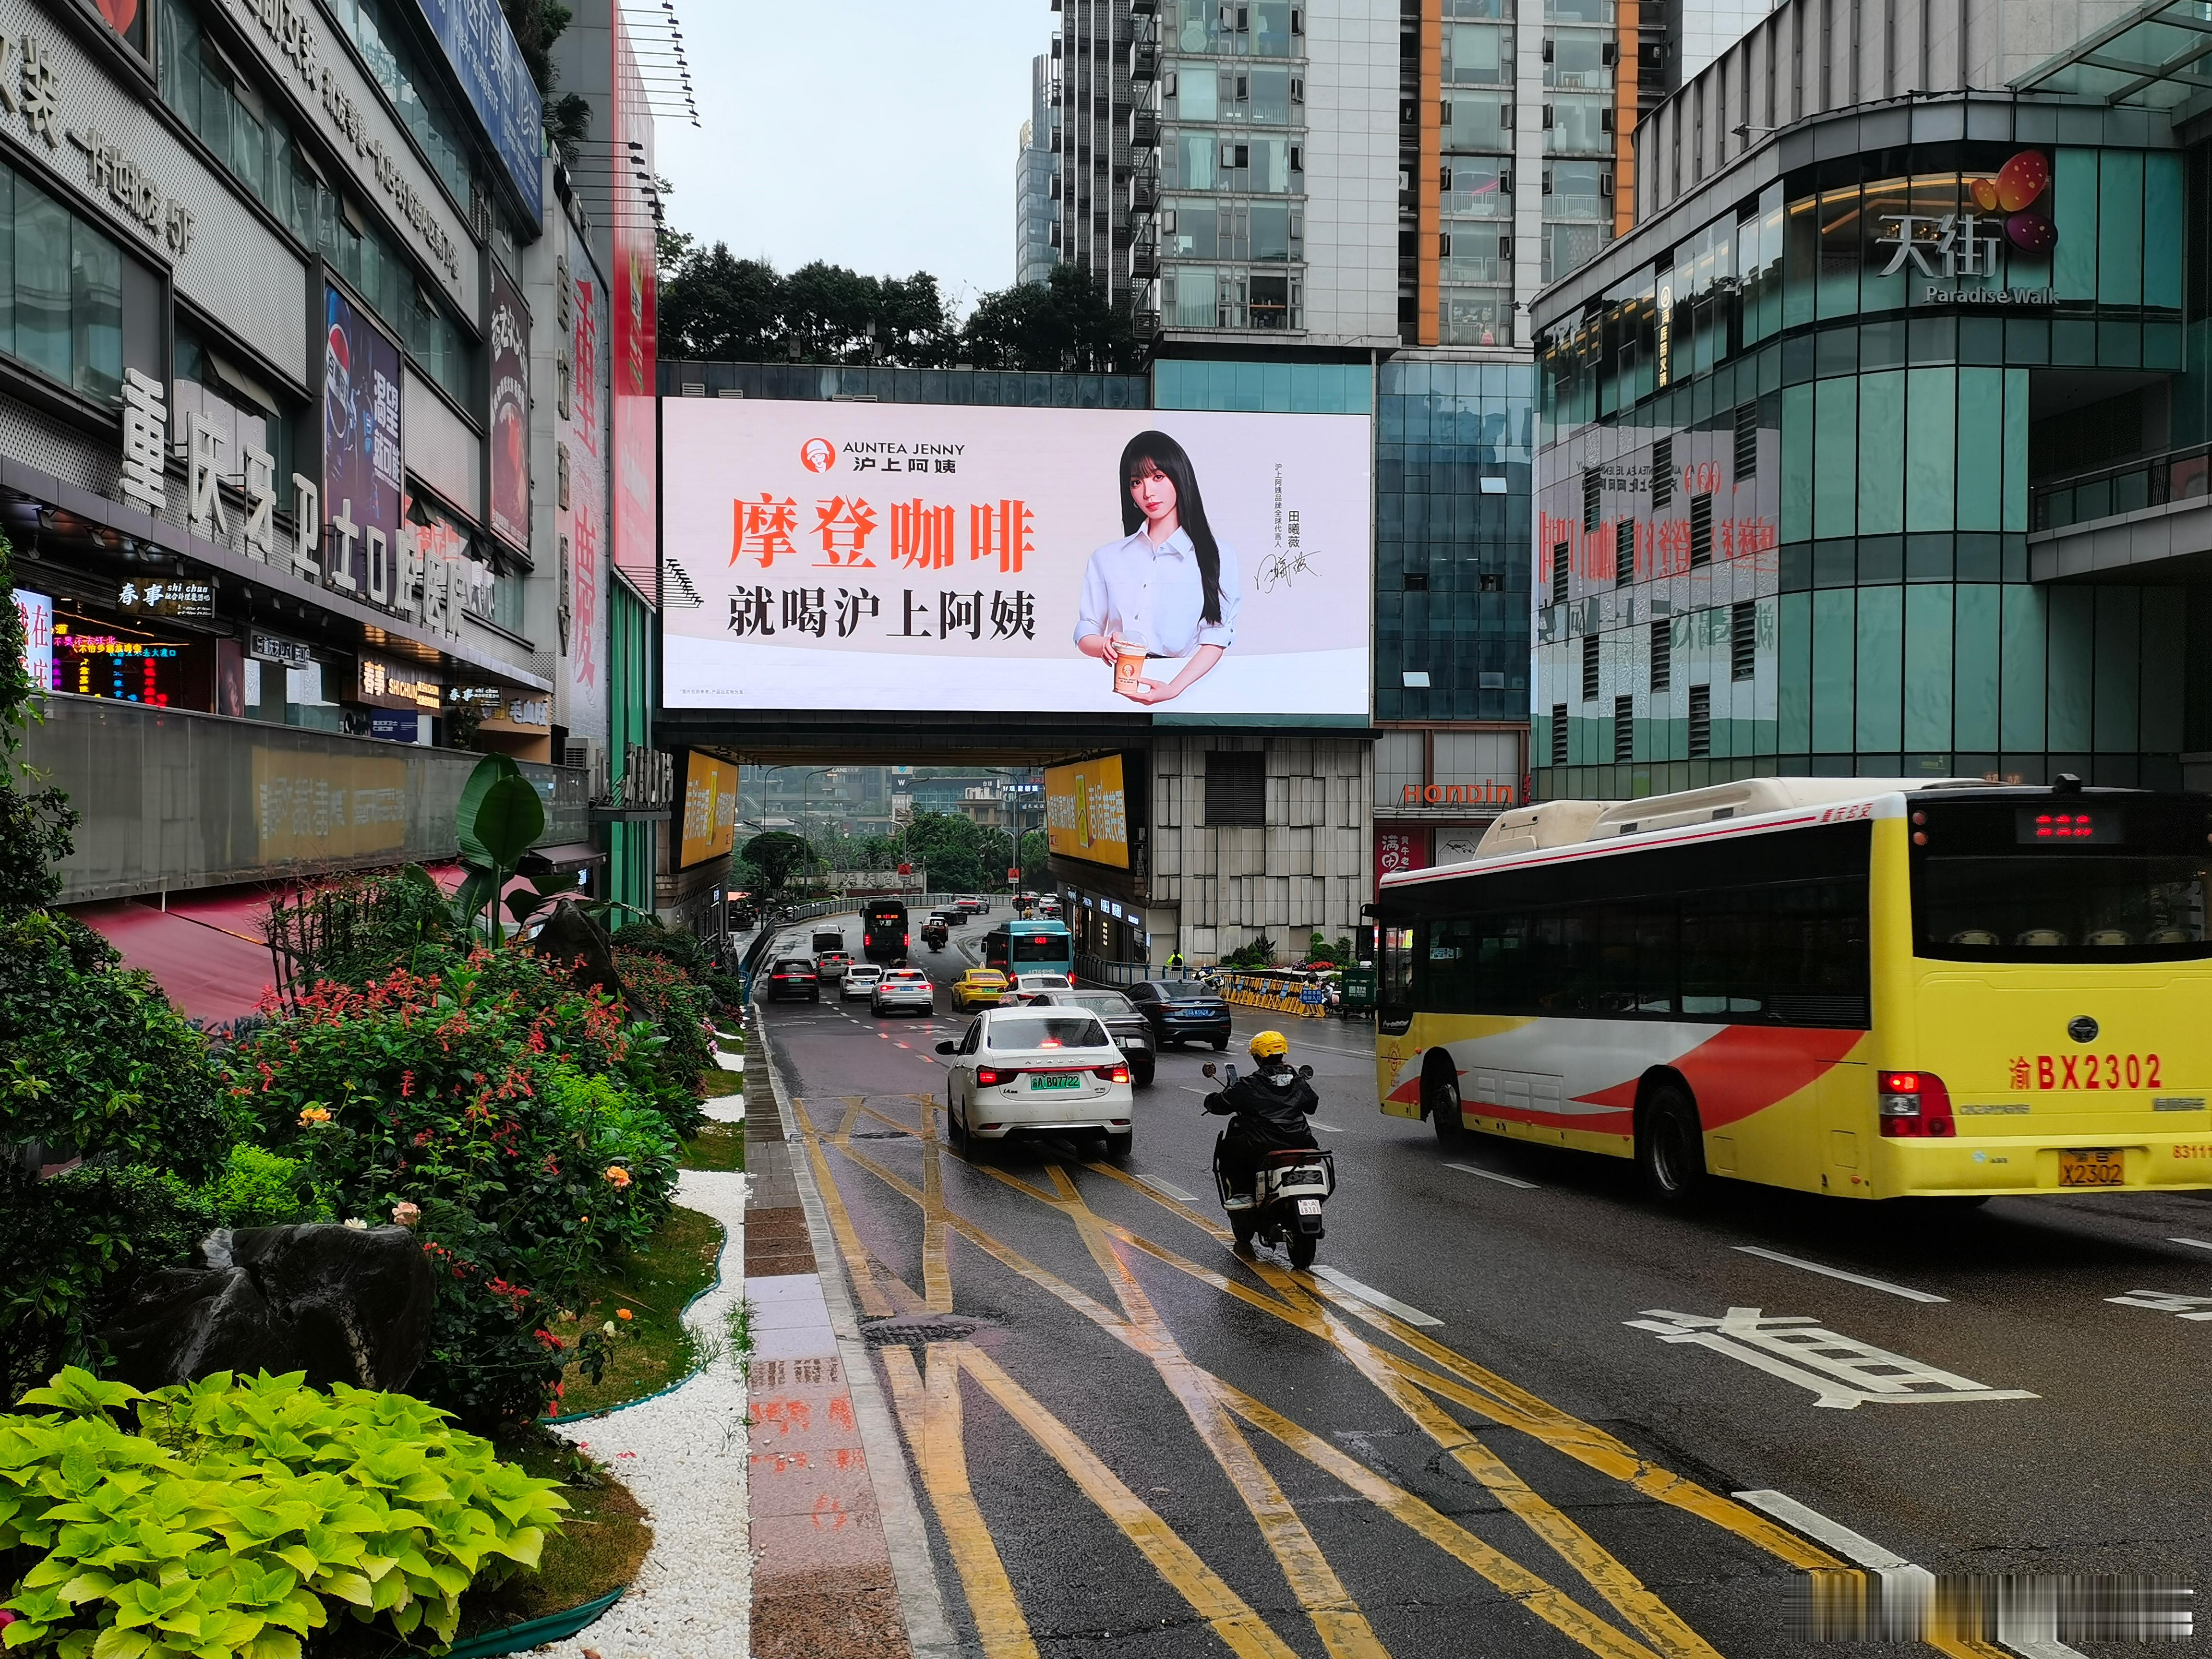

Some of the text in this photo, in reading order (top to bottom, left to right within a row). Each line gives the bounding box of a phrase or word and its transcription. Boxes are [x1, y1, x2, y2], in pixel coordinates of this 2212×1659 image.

[166, 198, 193, 254] 5F
[1875, 213, 2001, 279] 天街
[1923, 286, 2060, 305] Paradise Walk
[373, 369, 398, 439] 渴望
[373, 428, 400, 483] 就可能
[843, 441, 965, 456] AUNTEA JENNY
[853, 457, 956, 474] 沪上阿姨
[728, 492, 1035, 574] 摩登咖啡
[1288, 510, 1300, 548] 田曦薇
[118, 582, 164, 607] 春事
[167, 583, 208, 593] shi chun
[727, 584, 1037, 641] 就喝沪上阿姨
[388, 678, 399, 696] SHI
[400, 681, 418, 700] CHUN
[1819, 803, 1875, 823] 重庆公交
[2009, 1053, 2162, 1090] 渝BX2302
[2063, 1164, 2122, 1184] X2302
